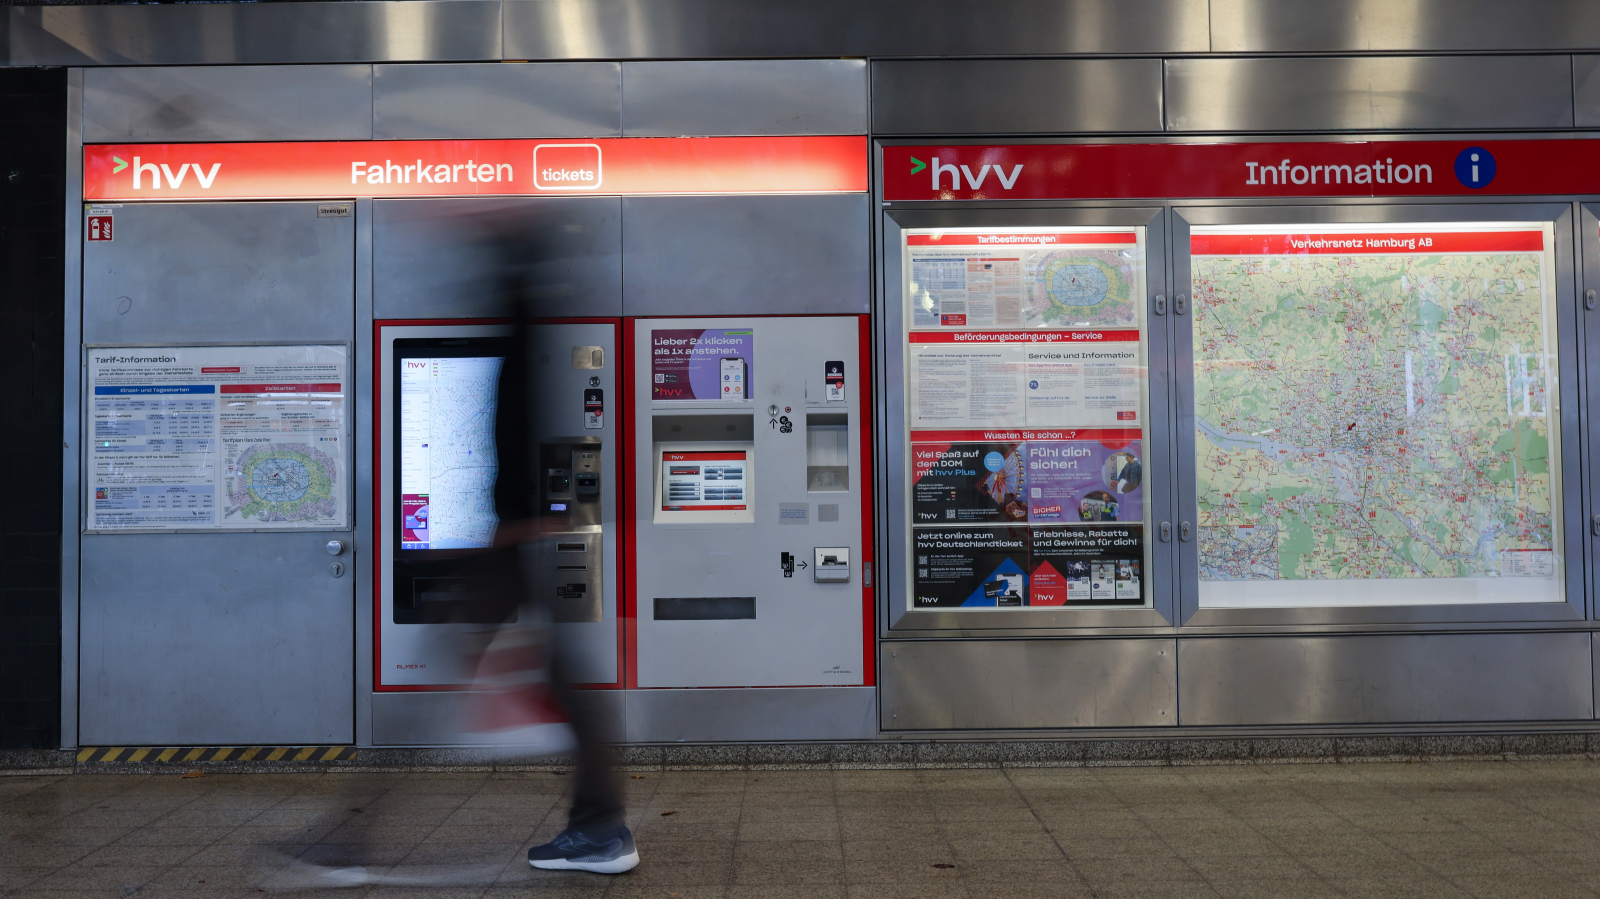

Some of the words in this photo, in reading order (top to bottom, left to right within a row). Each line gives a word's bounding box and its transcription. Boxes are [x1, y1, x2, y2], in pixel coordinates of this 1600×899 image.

[132, 156, 222, 189] hvv
[351, 159, 513, 184] Fahrkarten
[542, 168, 594, 182] tickets
[932, 157, 1024, 190] hvv
[1245, 158, 1432, 185] Information
[977, 236, 1056, 244] Tarifbestimmungen
[1290, 238, 1363, 248] Verkehrsnetz
[1366, 238, 1416, 250] Hamburg
[1418, 238, 1432, 247] AB
[654, 337, 688, 345] Lieber
[954, 332, 1062, 343] Beförderungsbedingungen
[1072, 332, 1102, 340] Service
[660, 388, 682, 396] hvv
[984, 432, 1020, 440] Wussten
[1022, 431, 1035, 439] Sie
[936, 451, 960, 459] Spaß
[1030, 448, 1058, 457] Fühl
[1062, 447, 1091, 456] dich
[1030, 460, 1077, 469] sicher!
[1033, 506, 1061, 514] SICHER
[1033, 530, 1086, 538] Erlebnisse,
